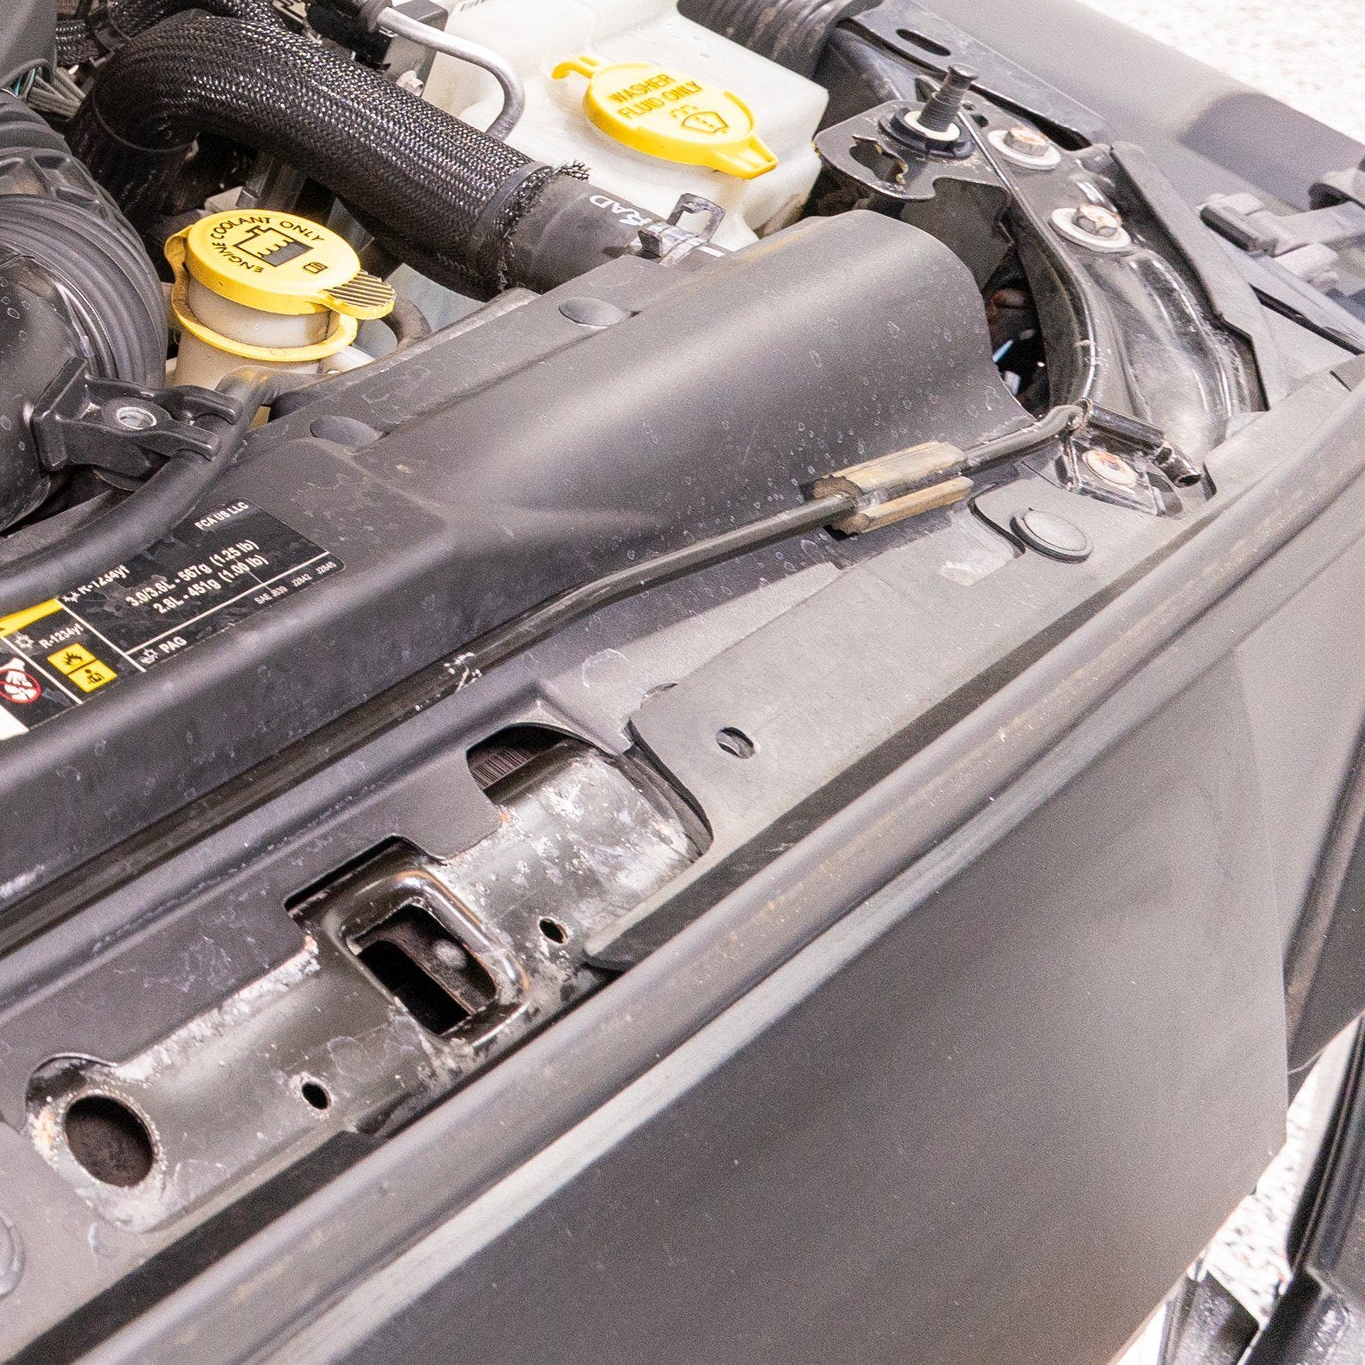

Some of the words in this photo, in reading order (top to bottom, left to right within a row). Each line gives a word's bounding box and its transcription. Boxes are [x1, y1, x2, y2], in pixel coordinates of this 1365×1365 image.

[608, 74, 676, 103] WASHER
[618, 97, 665, 119] FLUID
[661, 81, 703, 102] ONLY
[210, 217, 272, 240] COOLANT
[279, 220, 326, 242] ONLY
[211, 241, 264, 273] ENGINE
[195, 515, 217, 532] FCA
[214, 510, 230, 522] US
[228, 501, 249, 516] LLC
[126, 580, 176, 607] 3.0/3.6L
[177, 563, 213, 582] 567g
[209, 546, 242, 568] (1.25
[236, 539, 260, 553] lb)
[153, 594, 184, 614] 2.8L
[187, 578, 222, 599] 451g
[218, 562, 250, 583] (1.00
[246, 554, 269, 568] lb)
[39, 623, 84, 649] R-1234yf
[159, 636, 188, 654] PAG
